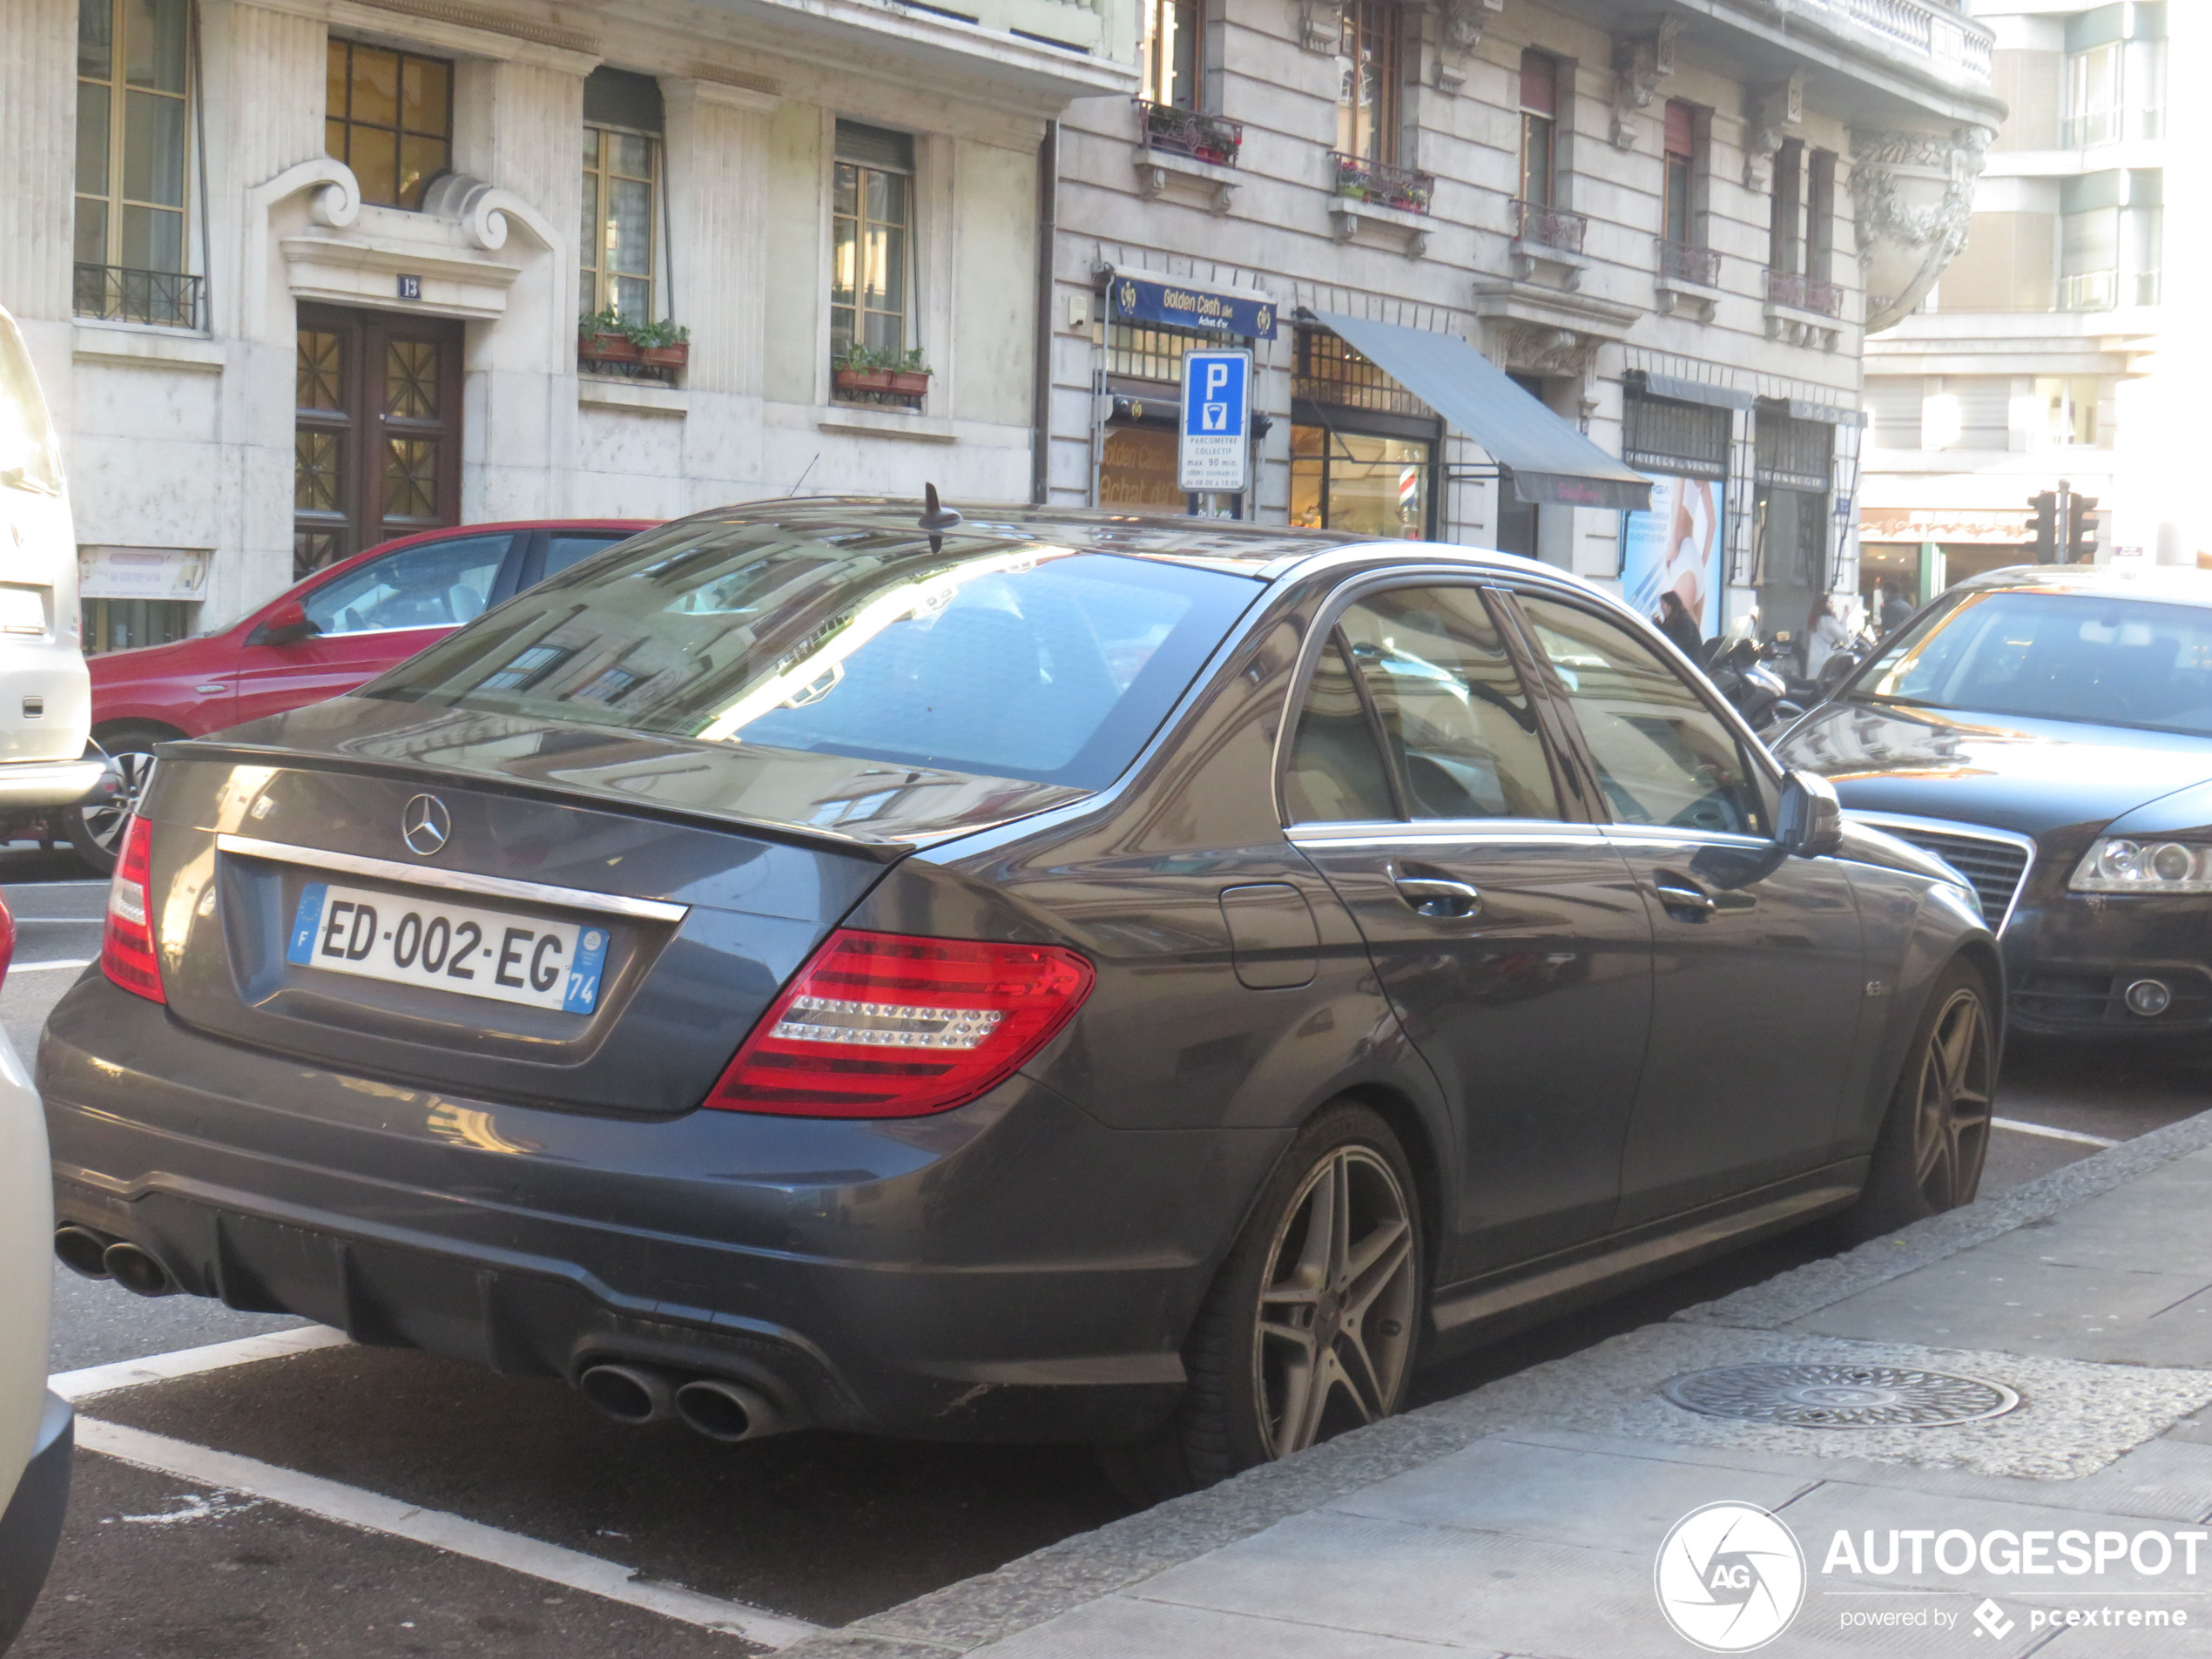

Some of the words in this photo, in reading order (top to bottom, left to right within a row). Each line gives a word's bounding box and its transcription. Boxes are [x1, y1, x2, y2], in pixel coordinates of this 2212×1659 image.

[403, 278, 418, 297] 13
[1163, 288, 1196, 312] Golden
[1197, 295, 1220, 316] Cash
[1198, 314, 1216, 327] Achat
[1217, 317, 1229, 328] d'or
[1206, 363, 1228, 401] P
[1208, 458, 1219, 468] 90
[1099, 475, 1145, 503] Achat
[298, 931, 308, 948] F
[321, 900, 563, 992] ED-002-EG
[568, 973, 595, 1003] 74
